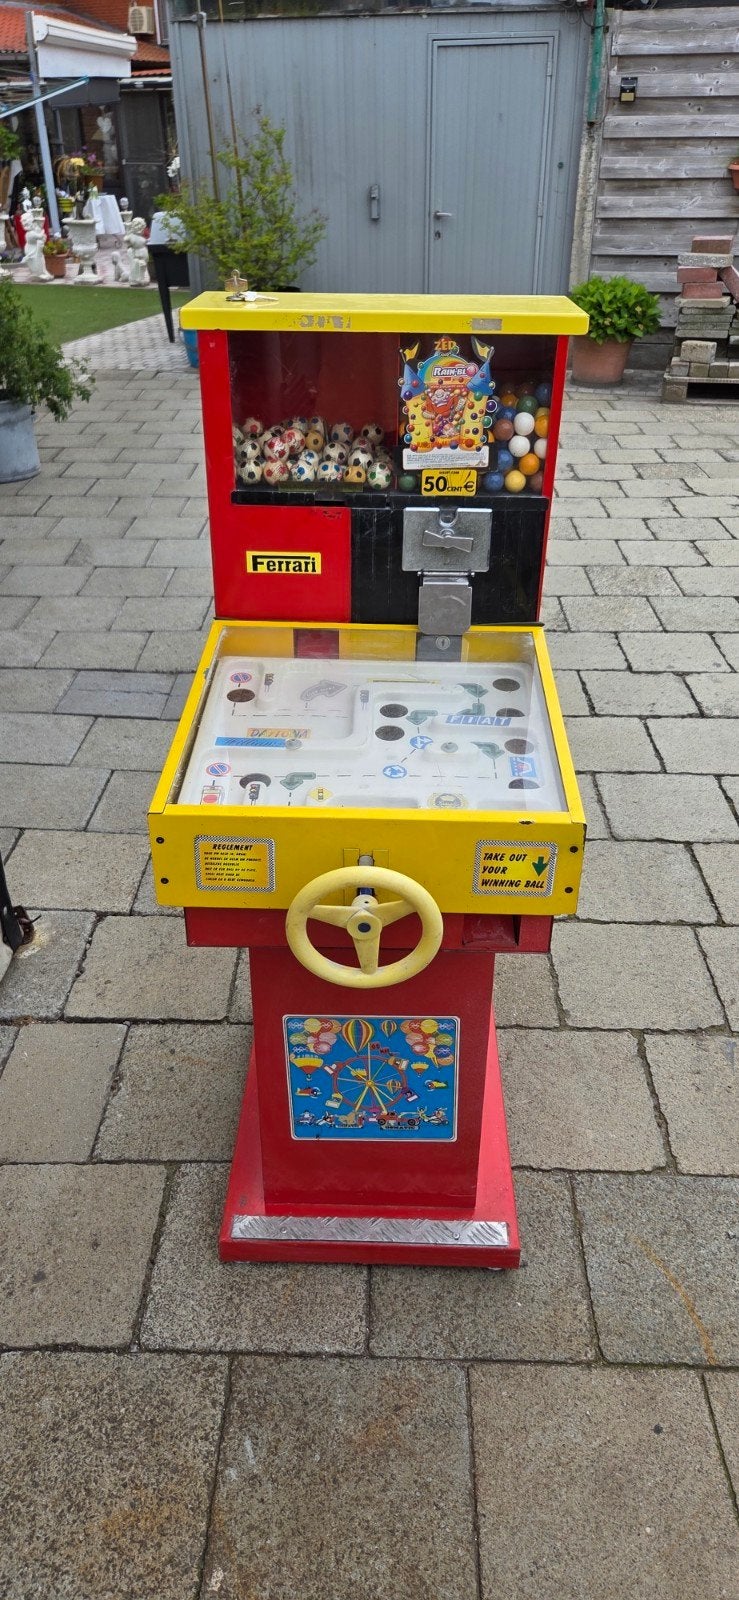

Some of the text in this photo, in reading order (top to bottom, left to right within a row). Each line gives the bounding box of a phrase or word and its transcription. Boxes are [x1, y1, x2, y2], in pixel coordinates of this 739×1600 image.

[434, 340, 457, 351] ZED
[423, 475, 448, 492] 50
[463, 481, 475, 492] €
[251, 555, 317, 573] Ferrari
[449, 716, 510, 726] FIAT
[212, 843, 254, 851] REGLEMENT
[483, 853, 528, 862] TAKE OUT
[481, 866, 508, 874] YOUR
[481, 878, 545, 889] WINNING BALL
